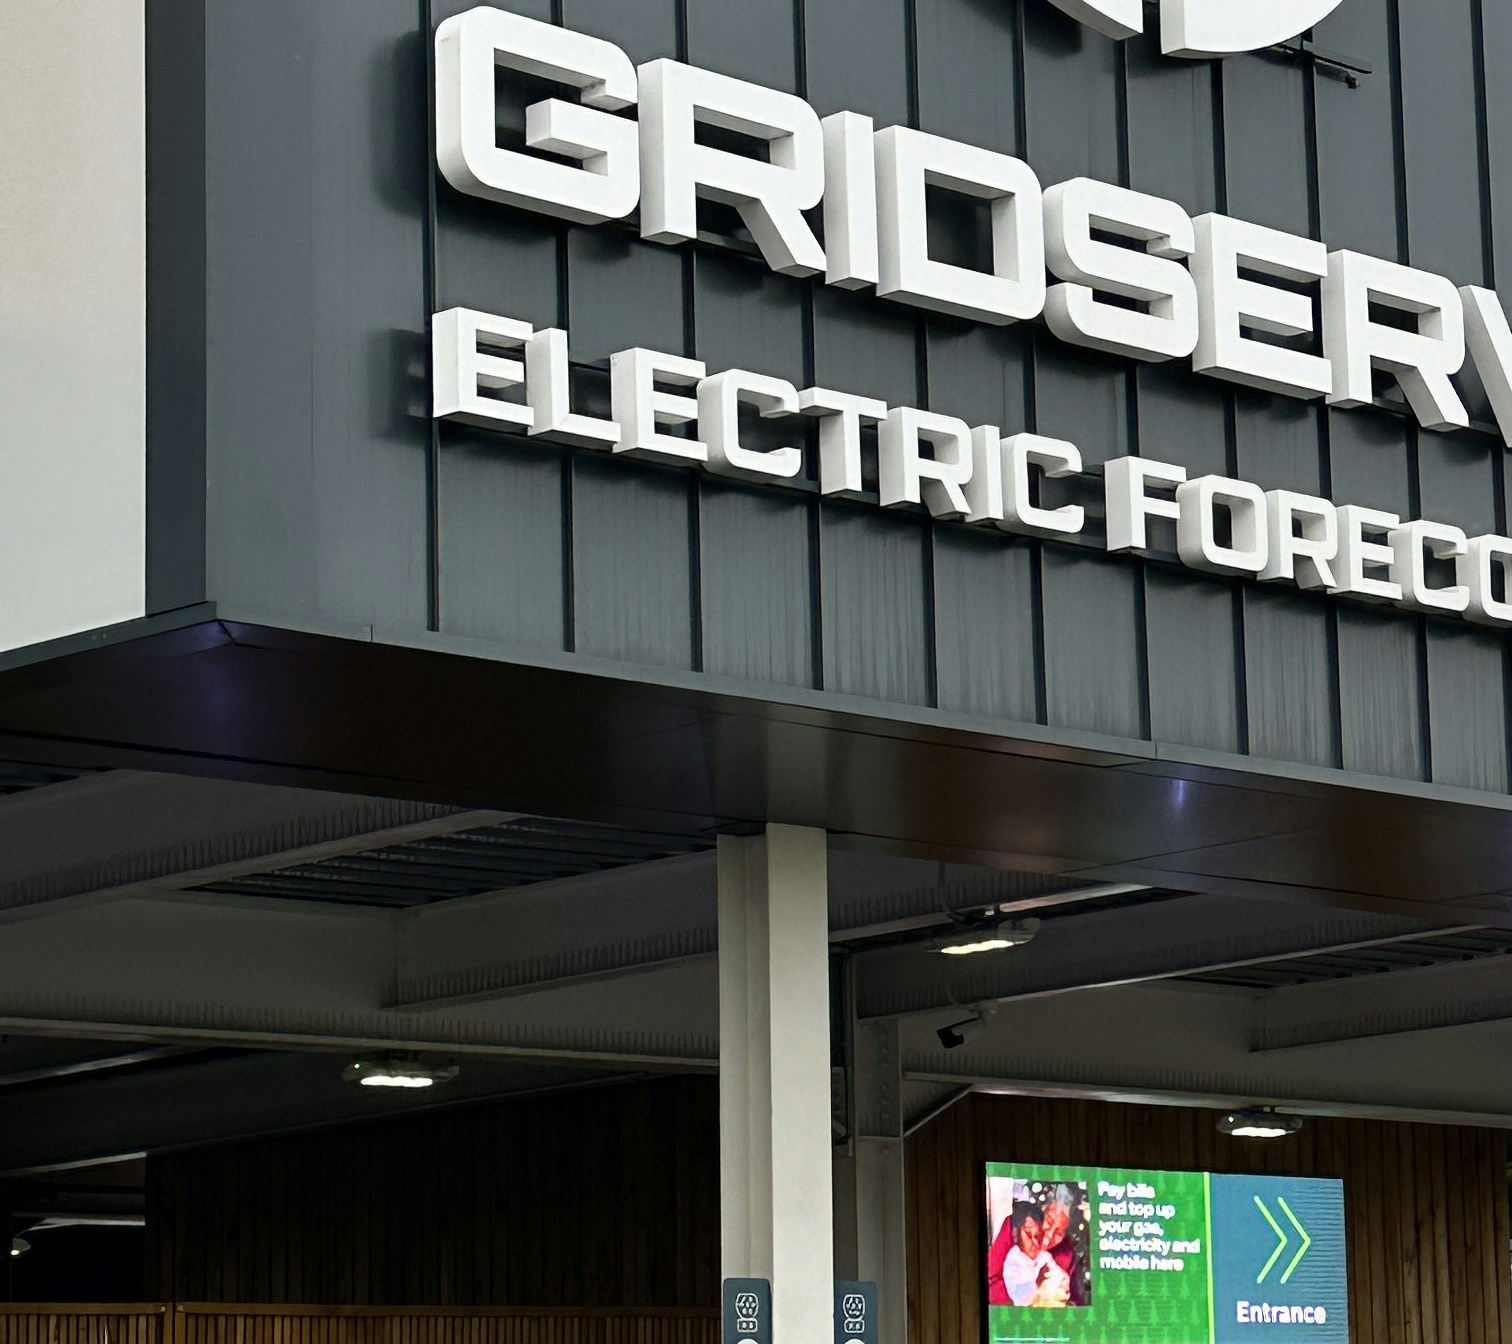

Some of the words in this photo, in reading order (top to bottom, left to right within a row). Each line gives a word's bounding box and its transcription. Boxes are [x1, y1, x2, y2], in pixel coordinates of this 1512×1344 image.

[433, 307, 1085, 535] ELECTRIC
[1099, 1201, 1127, 1215] and
[1128, 1202, 1154, 1218] top
[1156, 1204, 1176, 1219] up
[1098, 1220, 1132, 1236] your
[1099, 1236, 1171, 1256] electricity
[1172, 1238, 1200, 1253] and
[1100, 1255, 1149, 1270] mobile
[1150, 1255, 1184, 1271] here
[1236, 1300, 1326, 1325] Entrance
